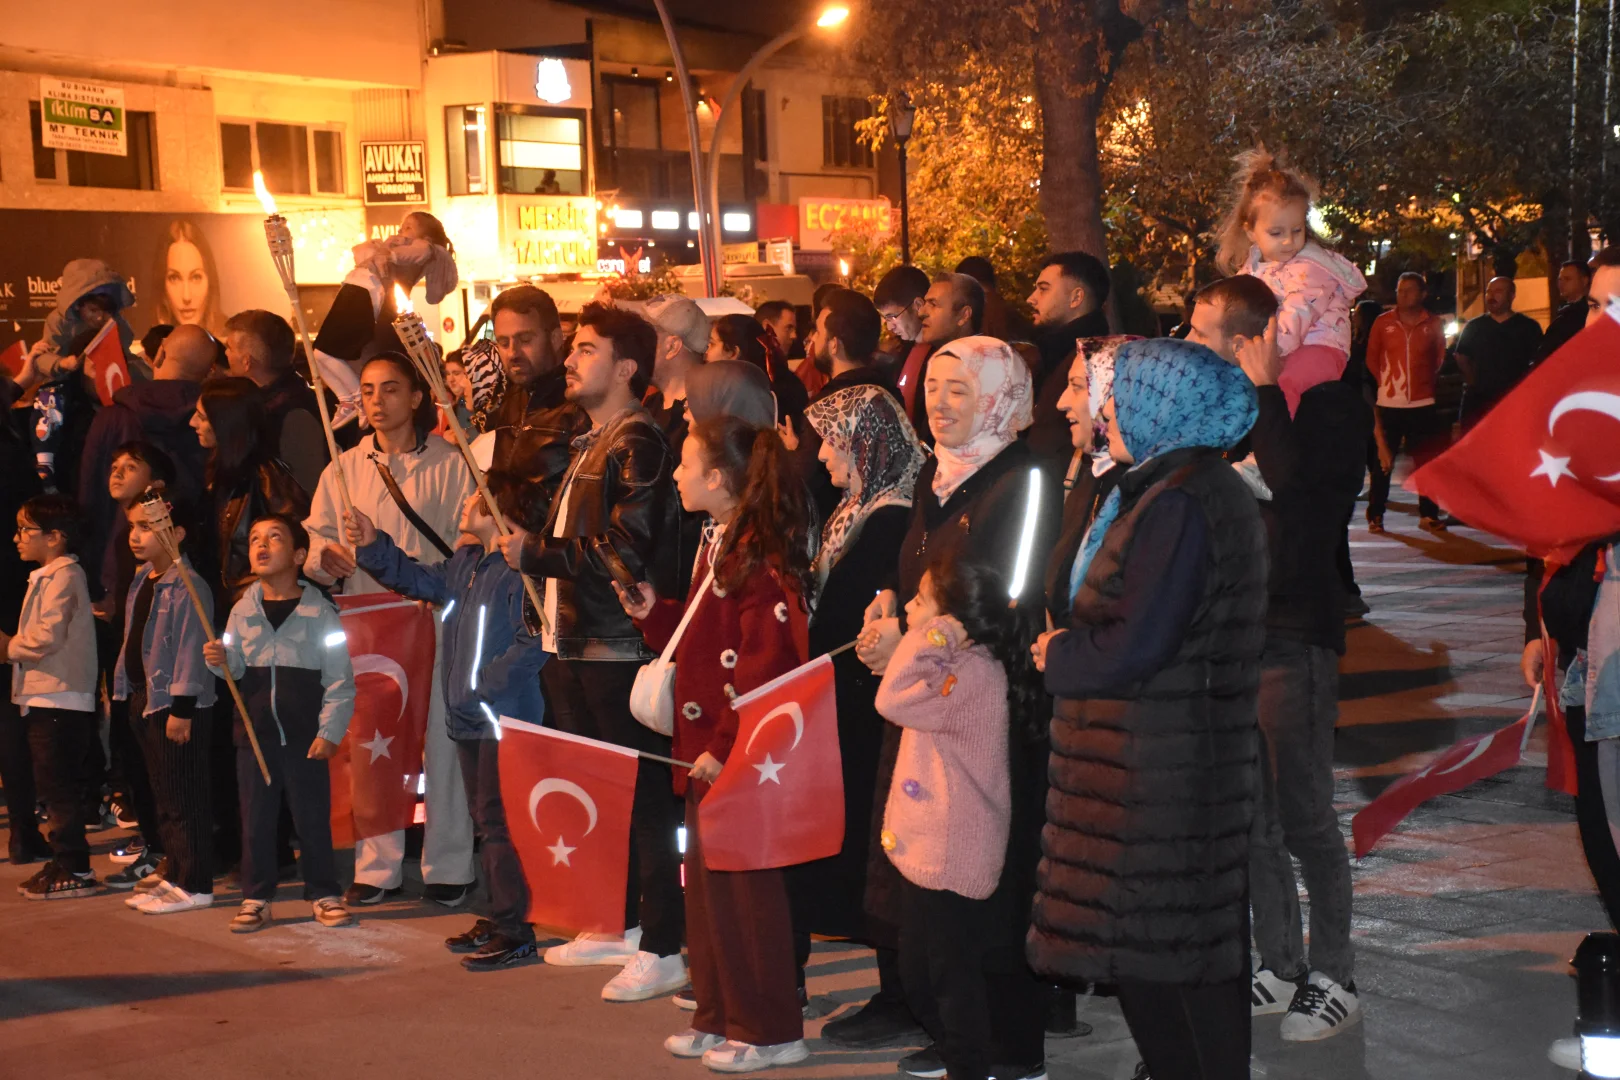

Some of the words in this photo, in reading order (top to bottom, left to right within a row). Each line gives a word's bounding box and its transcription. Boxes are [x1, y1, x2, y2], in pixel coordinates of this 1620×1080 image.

[49, 124, 66, 133] MT
[365, 145, 422, 172] AVUKAT
[366, 172, 395, 183] AHMET
